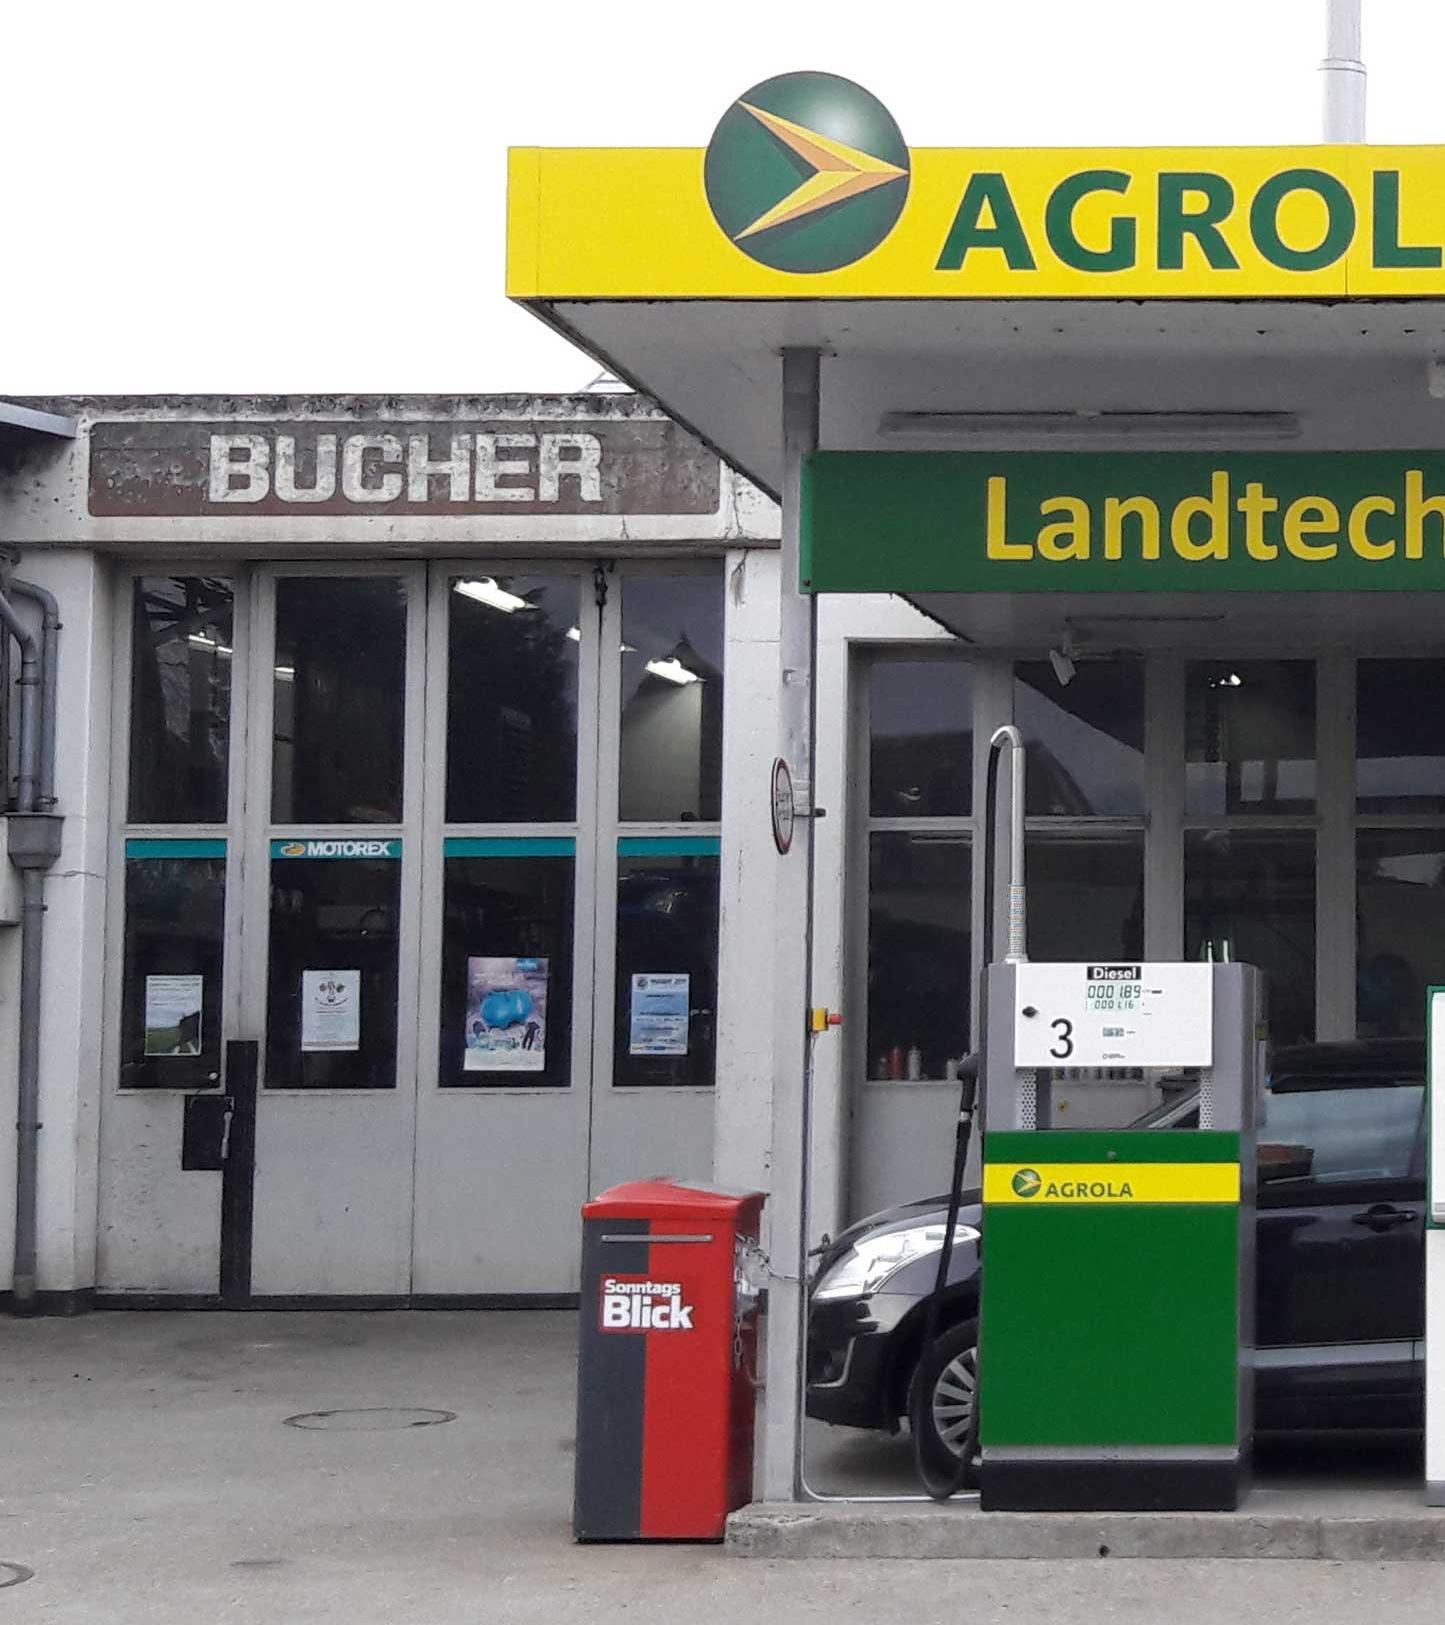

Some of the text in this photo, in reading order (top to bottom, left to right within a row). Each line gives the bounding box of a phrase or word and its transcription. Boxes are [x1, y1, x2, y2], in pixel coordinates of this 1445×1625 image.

[209, 433, 603, 503] BUCHER
[307, 841, 393, 857] MOTOREX
[1093, 966, 1138, 979] Diesel
[1050, 1017, 1074, 1060] 3
[1044, 1182, 1134, 1198] AGROLA
[604, 1279, 681, 1297] Sonntags
[602, 1295, 694, 1329] Blick
